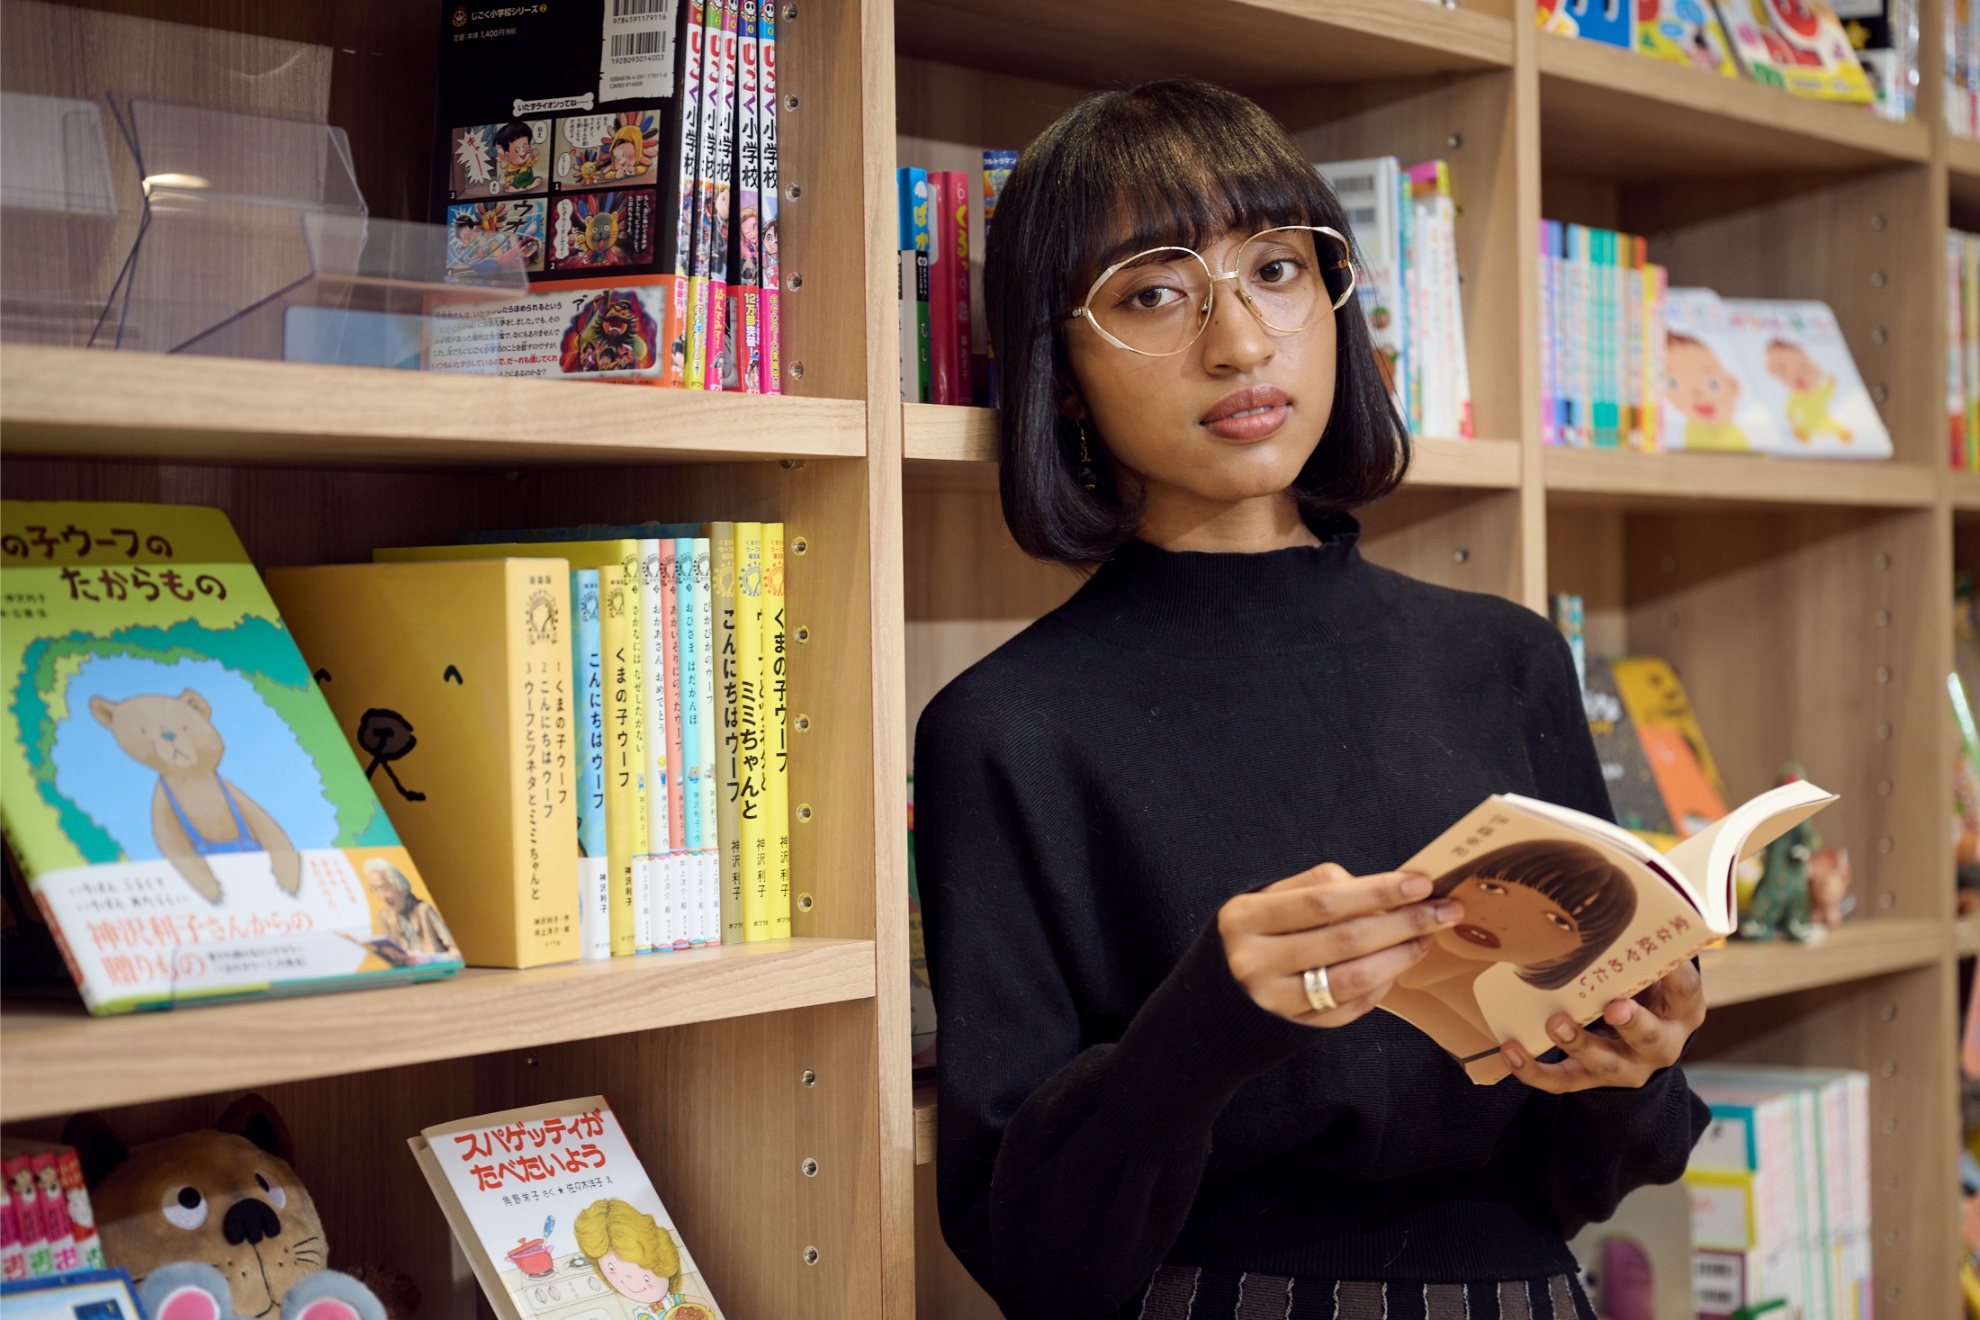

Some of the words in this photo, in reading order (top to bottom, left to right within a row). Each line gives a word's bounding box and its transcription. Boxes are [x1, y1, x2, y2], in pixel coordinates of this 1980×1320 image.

[471, 5, 538, 20] じごく小学校シリーズ
[613, 14, 666, 24] 9784591179116
[611, 54, 664, 64] 1928093014003
[742, 42, 758, 188] じごく小学校
[763, 45, 777, 188] じごく小学校
[0, 525, 173, 559] の子ウーフの
[60, 567, 227, 602] たからもの
[632, 606, 641, 664] さかなには
[653, 605, 662, 664] おかあさん
[686, 603, 694, 653] おひさま
[616, 648, 629, 787] くまの子ウーフ
[656, 673, 664, 734] おめでとう
[722, 609, 739, 803] こんにちはウーフ
[773, 608, 787, 772] くまの子ウーフ
[540, 681, 553, 819] こんにちはウーフ
[556, 681, 567, 804] くまの子ウーフ
[589, 653, 604, 809] こんにちはウーフ
[740, 681, 759, 819] ミミちゃんと
[524, 681, 540, 900] ウーフとツネタとミミちゃんと
[731, 840, 740, 900] 神沢利子
[756, 838, 765, 898] 神沢利子
[780, 835, 788, 897] 神沢利子
[86, 910, 314, 951] 神沢利子さんからの
[1578, 914, 1691, 999] 変な奴やめたい。
[102, 951, 207, 986] 贈りもの
[454, 1107, 604, 1162] スパゲッティが
[469, 1144, 607, 1192] たべたいよう
[502, 1190, 540, 1207] 角野栄子
[542, 1188, 555, 1198] さく
[606, 1176, 614, 1184] え
